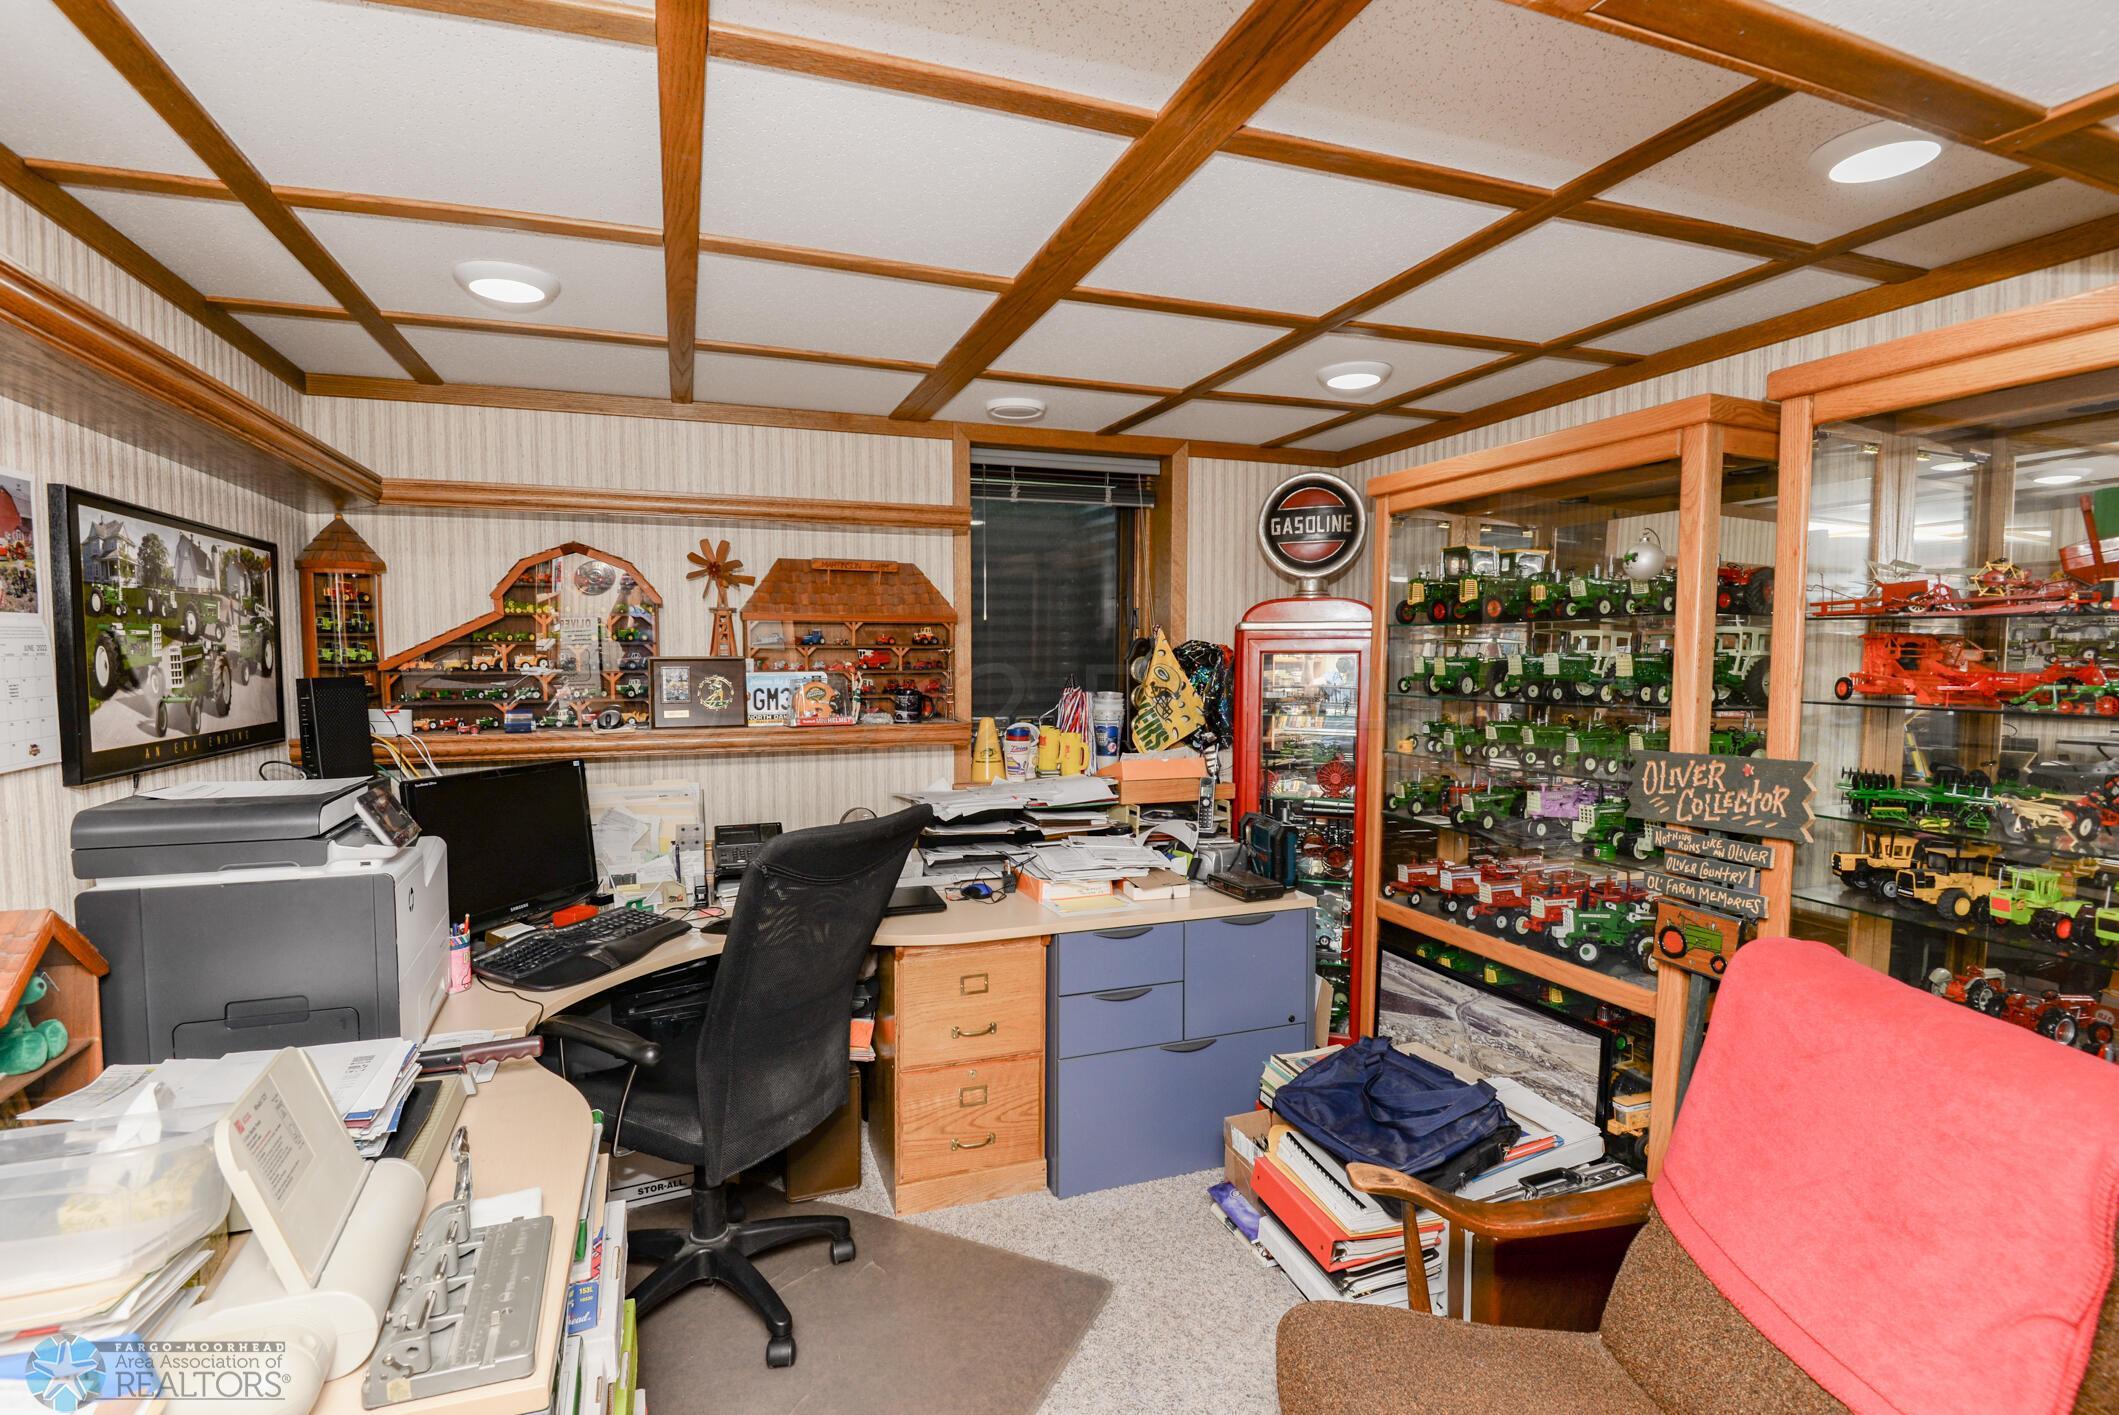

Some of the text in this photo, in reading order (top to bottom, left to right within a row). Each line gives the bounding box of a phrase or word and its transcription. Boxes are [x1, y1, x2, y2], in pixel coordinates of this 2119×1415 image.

[1271, 514, 1353, 536] GASOLINE
[145, 729, 250, 759] AN ERA ENDING
[1642, 760, 1727, 796] OLIVER
[1676, 779, 1791, 823] COLLECTOR
[1678, 841, 1701, 854] RUNS
[1701, 838, 1724, 850] LIKE
[1712, 849, 1725, 859] AN
[1727, 843, 1769, 865] OLIVER
[1665, 856, 1747, 885] OLIVER COUNTRY
[1665, 878, 1696, 899] FARM
[1698, 887, 1762, 915] MEMORIES
[637, 1179, 687, 1195] STOR-ALL
